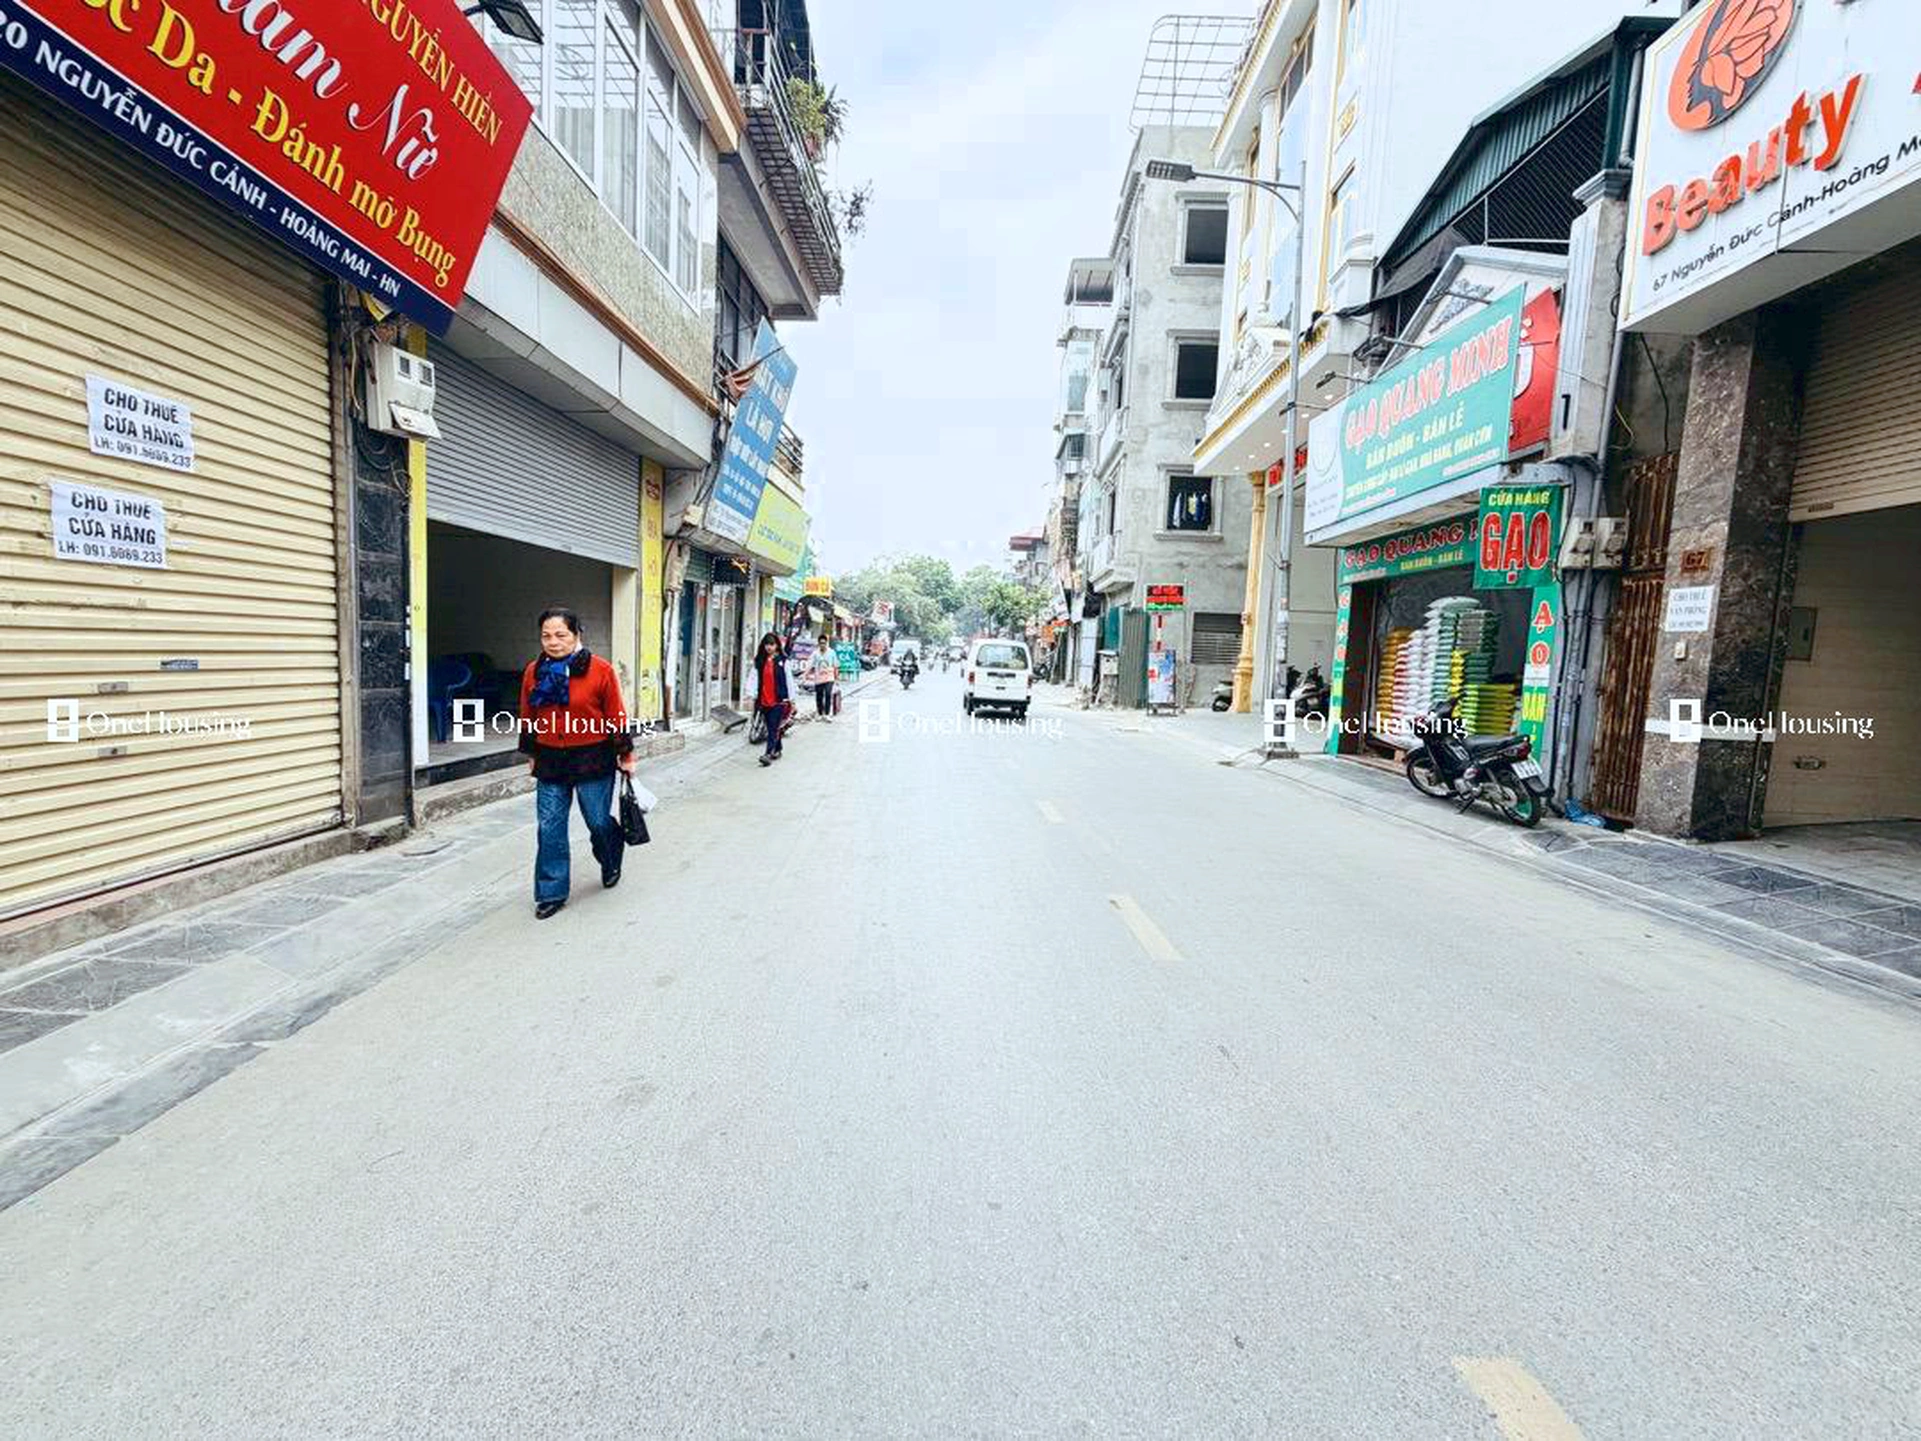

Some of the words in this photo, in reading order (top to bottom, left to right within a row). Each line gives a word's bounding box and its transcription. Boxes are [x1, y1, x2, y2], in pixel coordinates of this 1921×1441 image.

[147, 0, 216, 95] Da
[250, 86, 345, 195] Đánh
[395, 205, 456, 288] Bụng
[348, 84, 438, 180] Nữ
[34, 39, 153, 134] NGUYỄN
[155, 122, 208, 170] ĐỨC
[209, 156, 269, 210] CẢNH
[279, 207, 341, 258] HOÀNG
[340, 248, 372, 279] MAI
[379, 273, 401, 297] HN
[1641, 72, 1864, 257] Beauty
[104, 387, 138, 412] CHO
[141, 398, 179, 424] THUÊ
[103, 409, 138, 437] CỬA
[142, 423, 184, 449] HÀNG
[71, 490, 107, 513] CHO
[114, 497, 152, 520] THUÊ
[1488, 489, 1513, 507] CỬA
[1514, 489, 1551, 506] HÀNG
[68, 511, 106, 539] CỬA
[111, 521, 157, 545] HÀNG
[1384, 522, 1464, 563] QUANG
[1480, 509, 1551, 584] GẠO
